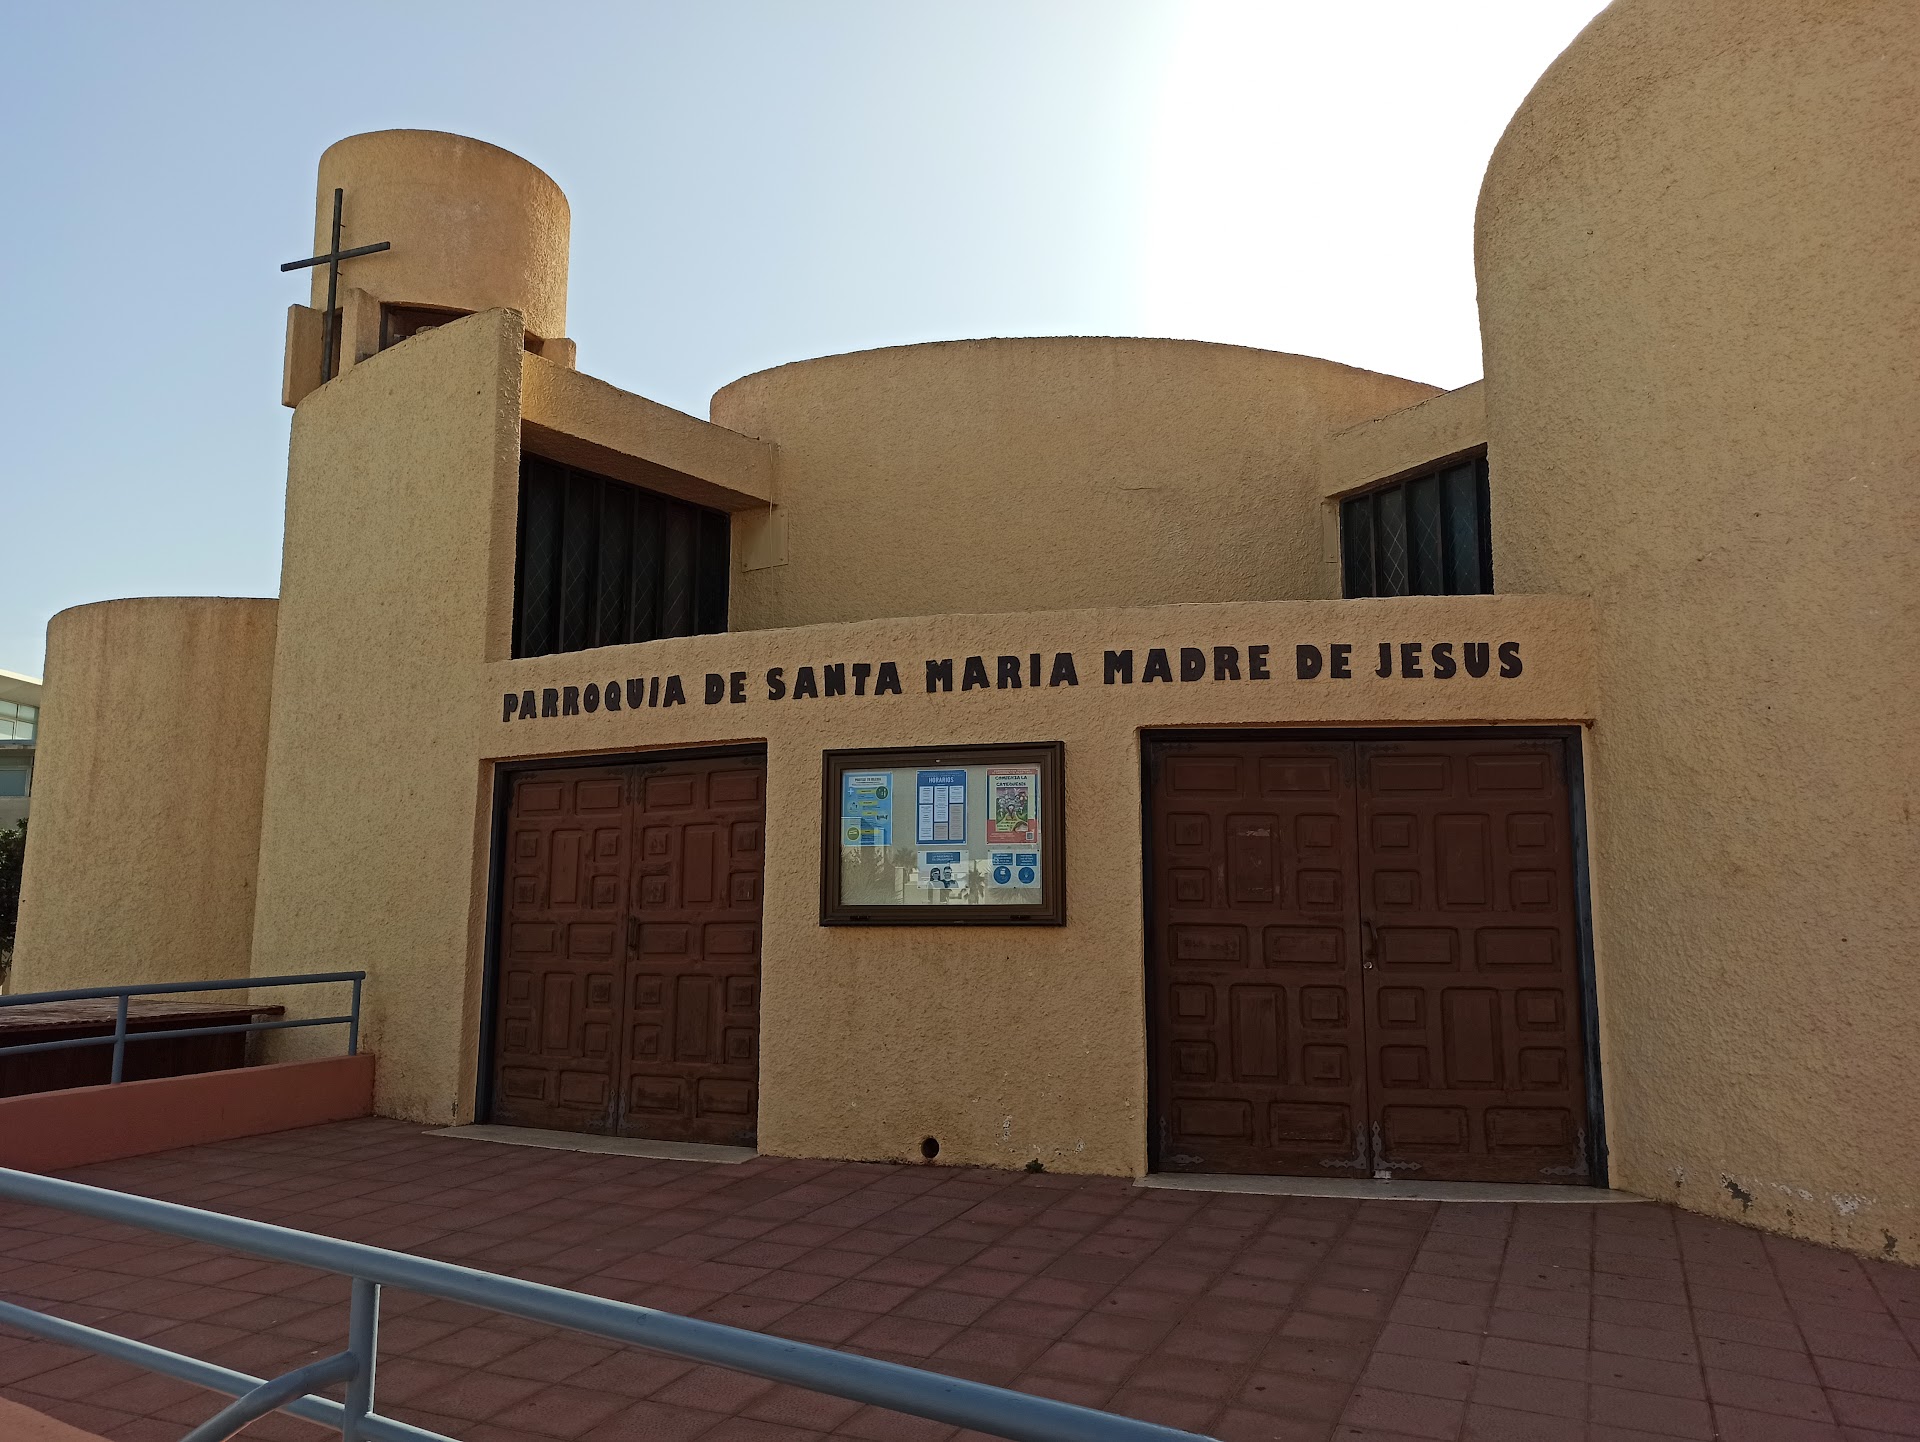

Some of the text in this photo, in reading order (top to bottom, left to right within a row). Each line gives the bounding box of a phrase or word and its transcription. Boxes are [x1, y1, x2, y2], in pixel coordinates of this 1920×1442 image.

[503, 641, 1523, 723] PARROQUIA DE SANTA MARIA MADRE DE JESUS
[928, 776, 955, 784] HORARIOS
